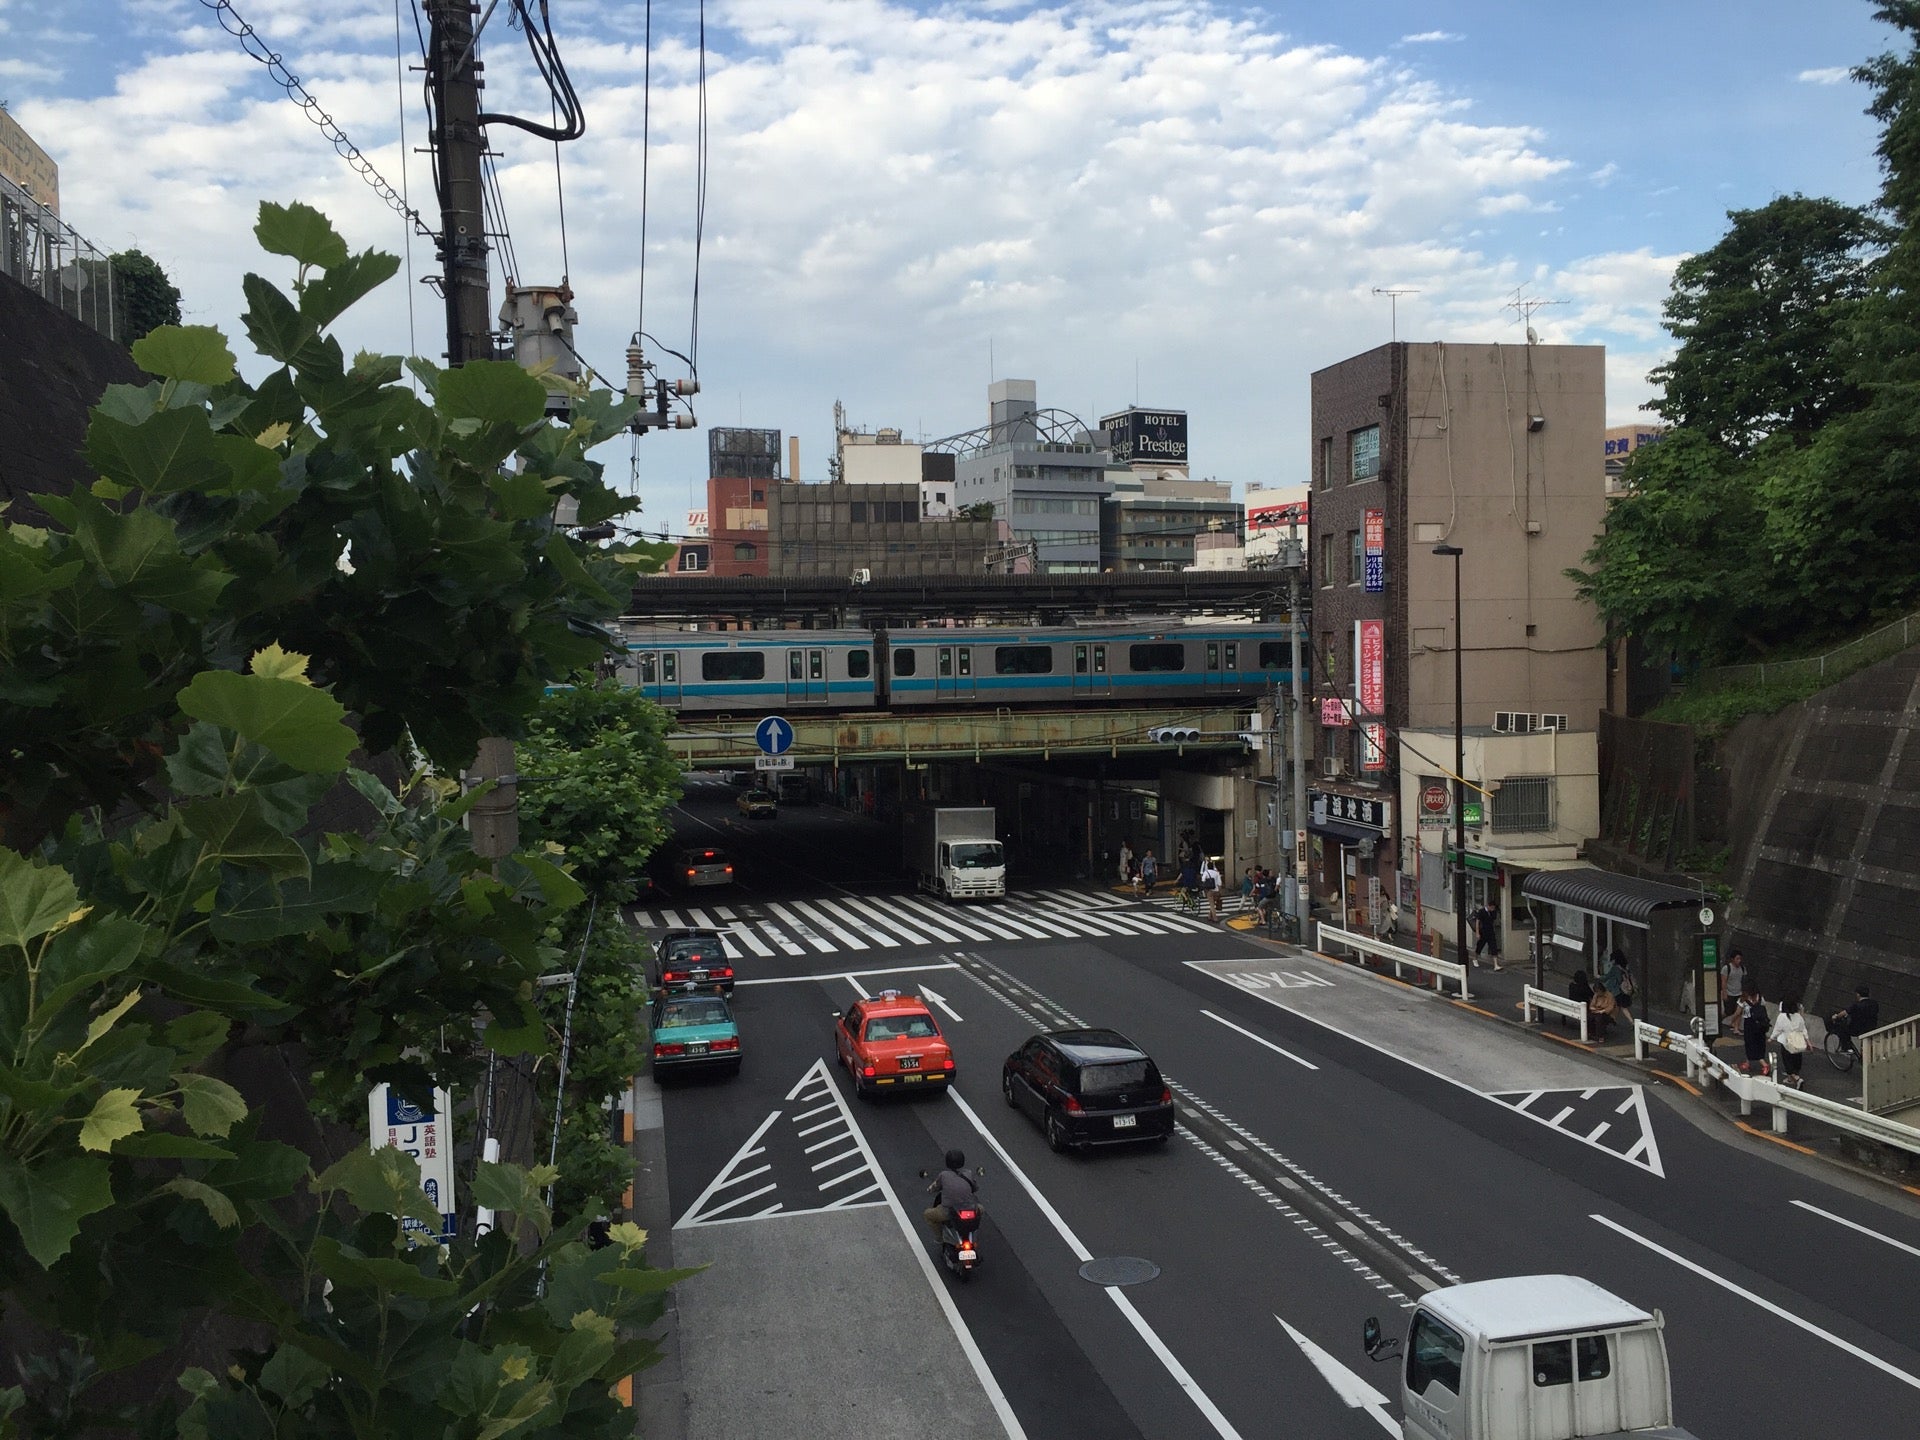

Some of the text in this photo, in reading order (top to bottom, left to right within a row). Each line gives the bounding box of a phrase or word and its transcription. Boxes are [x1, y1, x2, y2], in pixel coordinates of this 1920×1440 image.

[1105, 417, 1129, 431] HOTEL
[1144, 415, 1180, 426] HOTEL
[1139, 434, 1186, 456] Prestige
[424, 1124, 437, 1159] 英語塾
